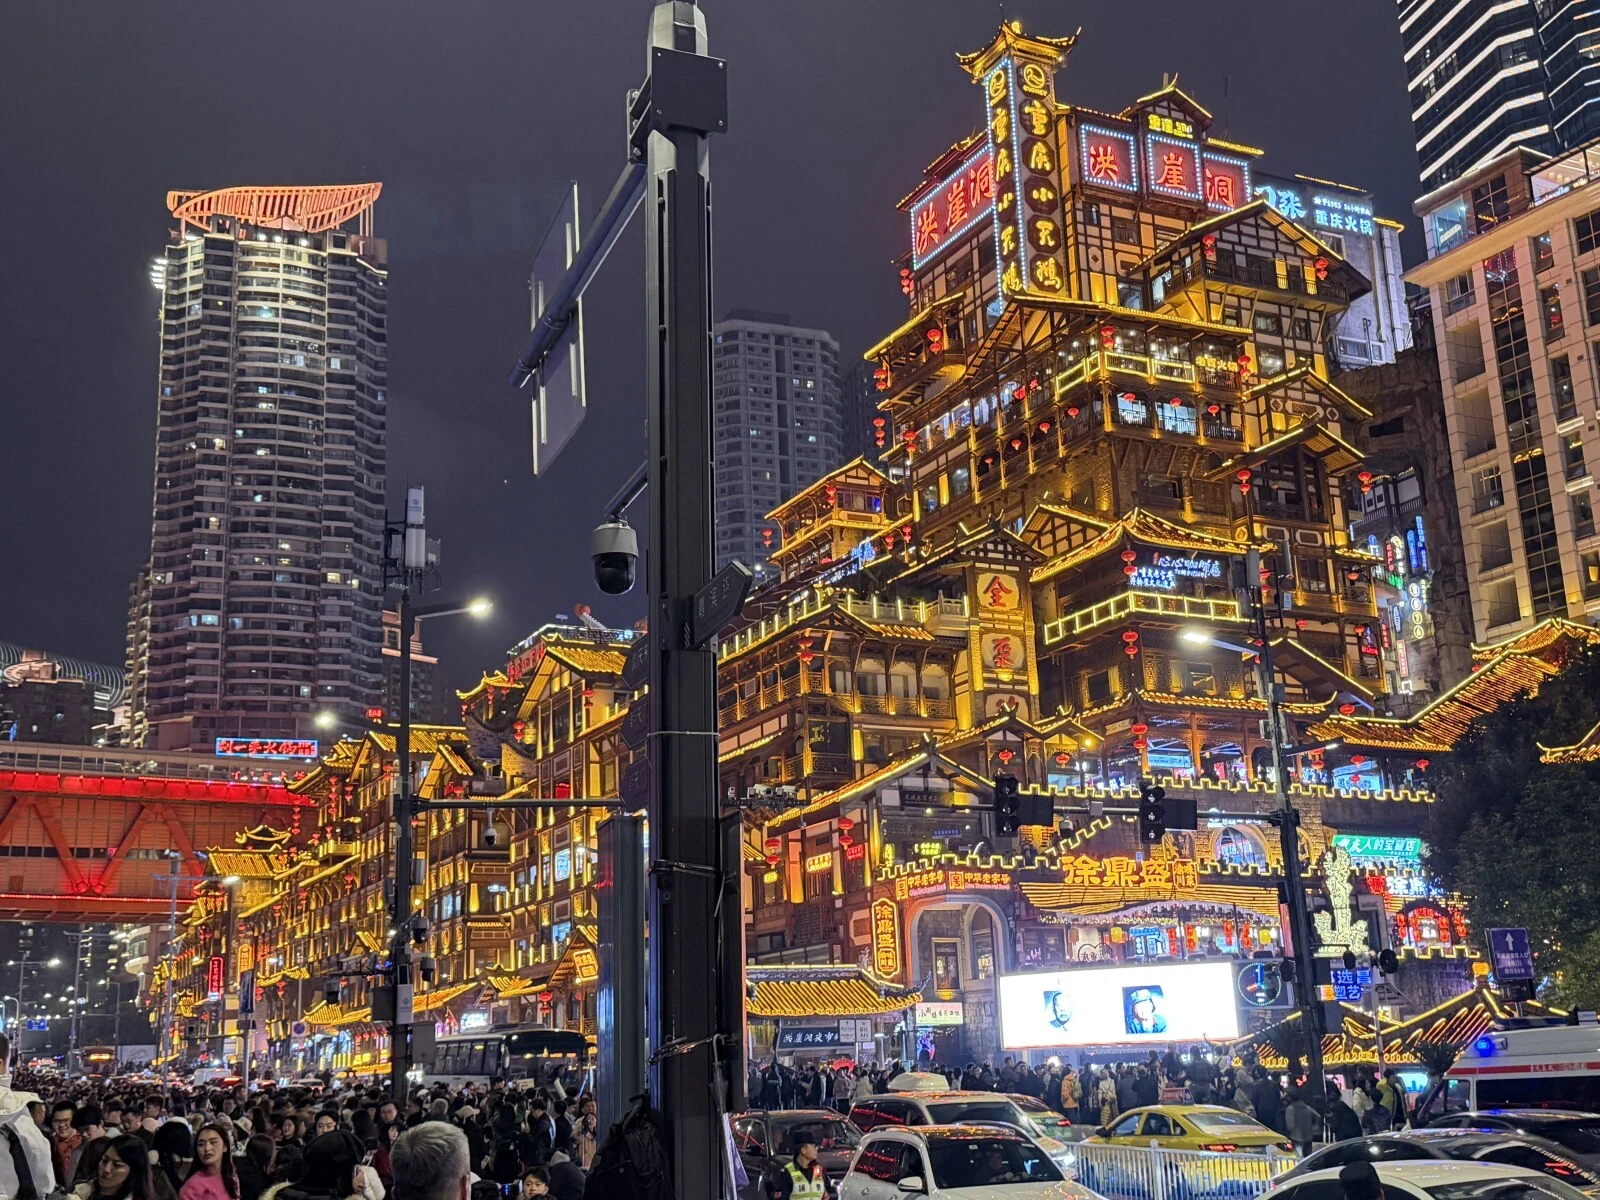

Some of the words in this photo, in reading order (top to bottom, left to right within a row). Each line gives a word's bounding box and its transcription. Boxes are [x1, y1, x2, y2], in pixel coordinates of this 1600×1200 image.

[1024, 100, 1061, 289] 重庆小天鹅
[1089, 145, 1235, 208] 洪崖洞
[916, 158, 995, 256] 洪崖洞
[1315, 209, 1373, 236] 重庆火锅
[907, 869, 945, 887] 中华老字号
[964, 872, 1011, 884] 中华老字号
[1061, 855, 1174, 889] 徐鼎盛
[875, 904, 895, 948] 徐鼎盛
